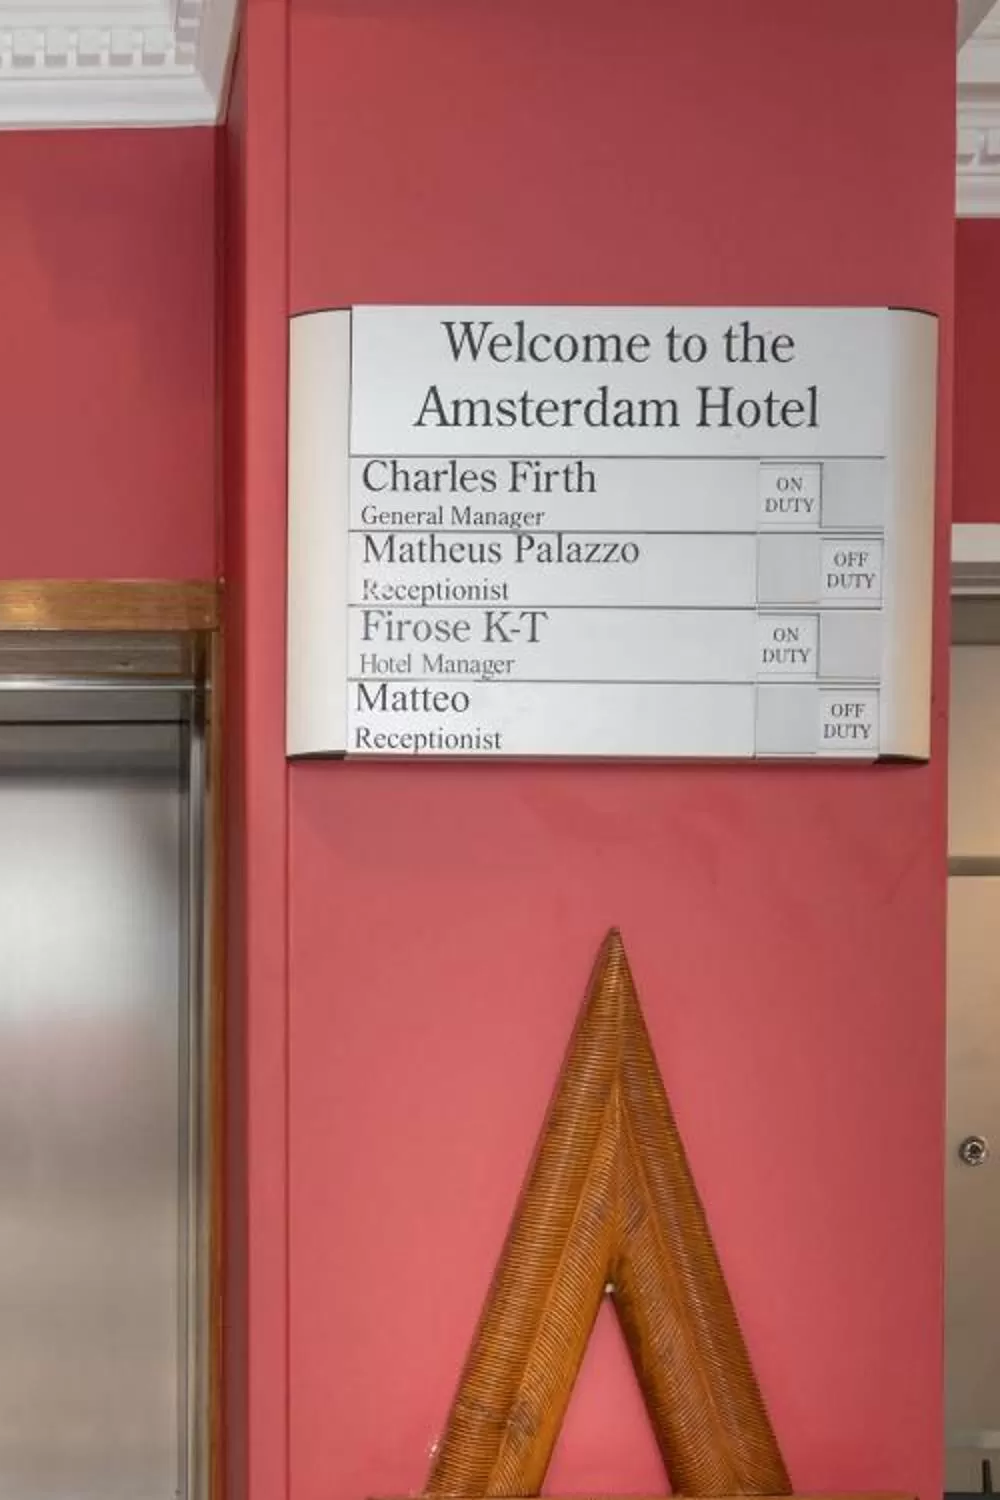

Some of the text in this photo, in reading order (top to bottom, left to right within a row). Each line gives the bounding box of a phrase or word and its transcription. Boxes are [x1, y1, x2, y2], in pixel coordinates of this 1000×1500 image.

[440, 319, 796, 364] Welcome to the
[412, 384, 820, 429] Amsterdam Hotel
[362, 459, 598, 493] Charles Firth
[775, 476, 804, 493] ON
[361, 504, 546, 529] General Manager
[764, 497, 815, 514] DUTY
[363, 533, 641, 564] Matheus Palazzo
[833, 551, 870, 568] OFF
[362, 579, 509, 605] Receptionist
[827, 573, 876, 589] DUTY
[361, 609, 549, 643] Firose K-T
[772, 627, 799, 643] ON
[360, 653, 516, 680] Hotel Manager
[762, 648, 811, 665] DUTY
[356, 683, 470, 713] Matteo
[830, 702, 866, 719] OFF
[355, 727, 502, 752] Receptionist
[823, 723, 872, 740] DUTY
